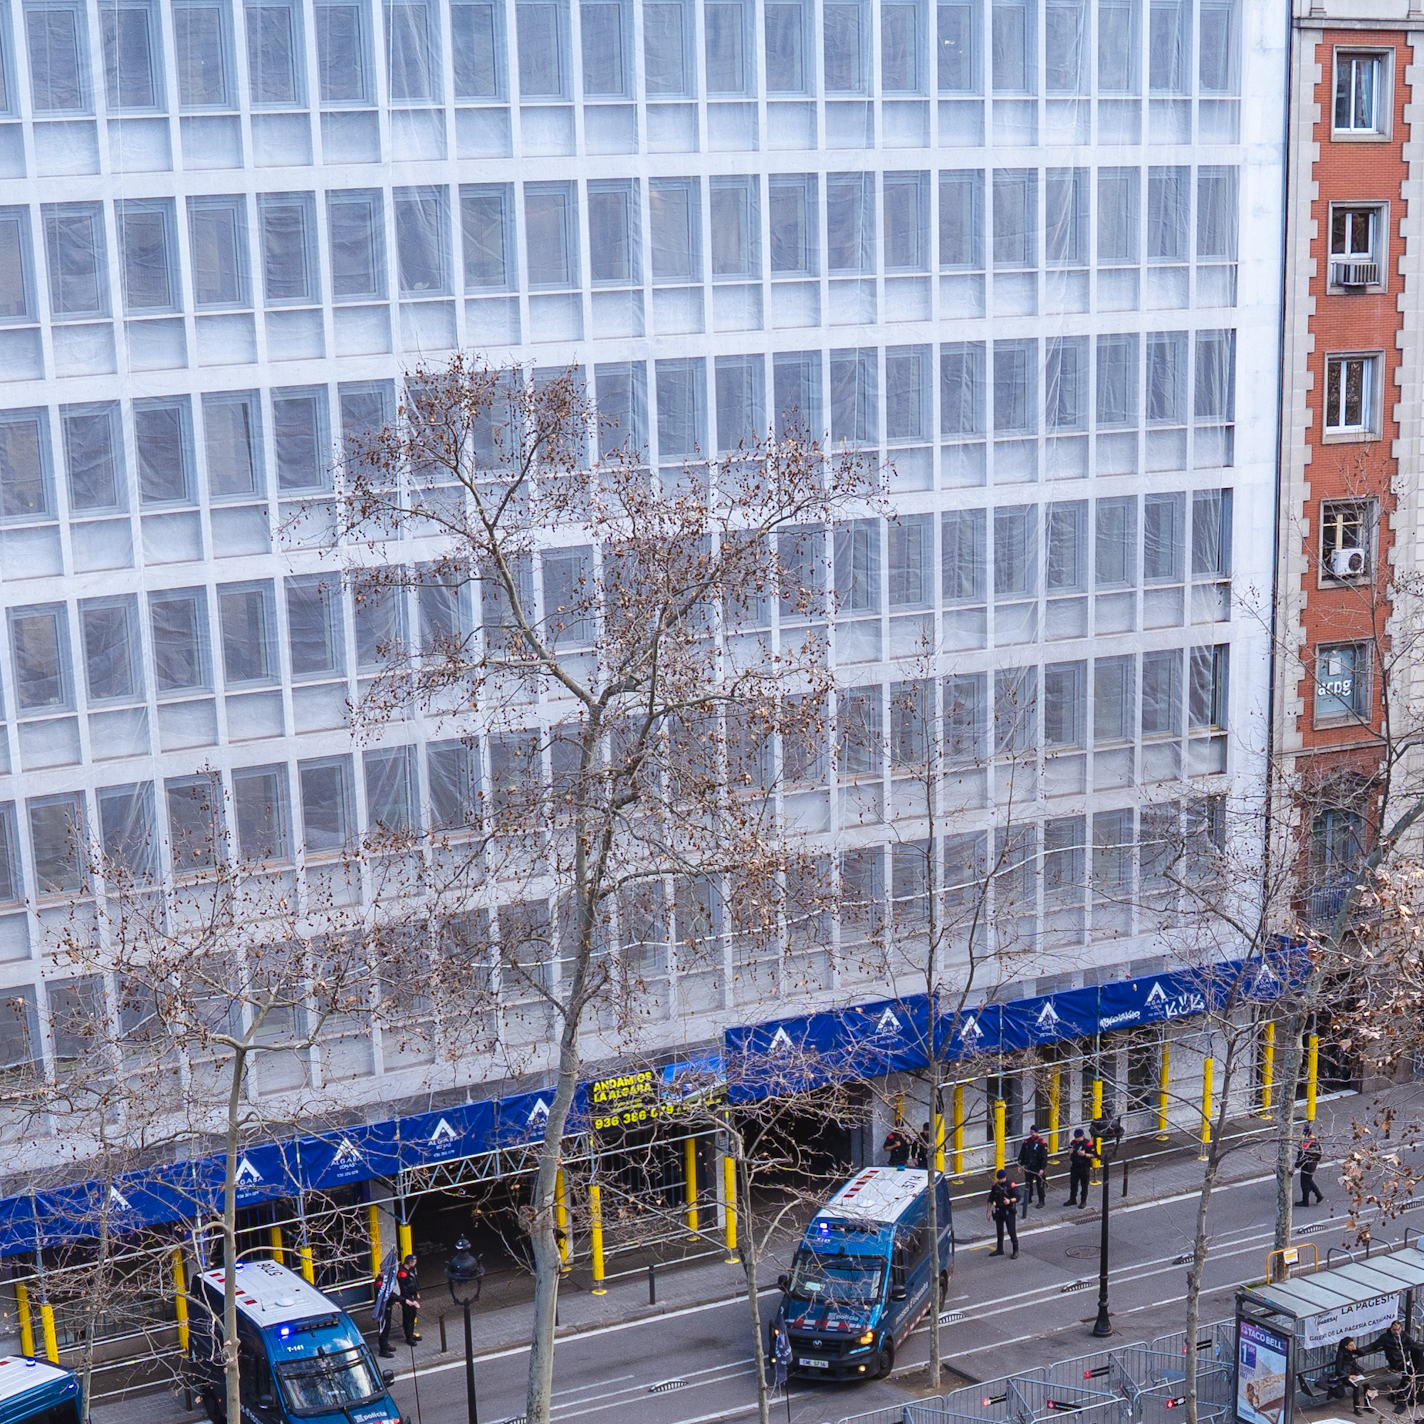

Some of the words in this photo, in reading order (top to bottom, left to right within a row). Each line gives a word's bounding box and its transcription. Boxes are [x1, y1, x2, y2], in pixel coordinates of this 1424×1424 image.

[595, 1116, 619, 1129] 936
[623, 1110, 647, 1124] 386
[1247, 1328, 1266, 1342] TACO
[1266, 1336, 1283, 1350] BELL
[363, 1411, 388, 1421] policia
